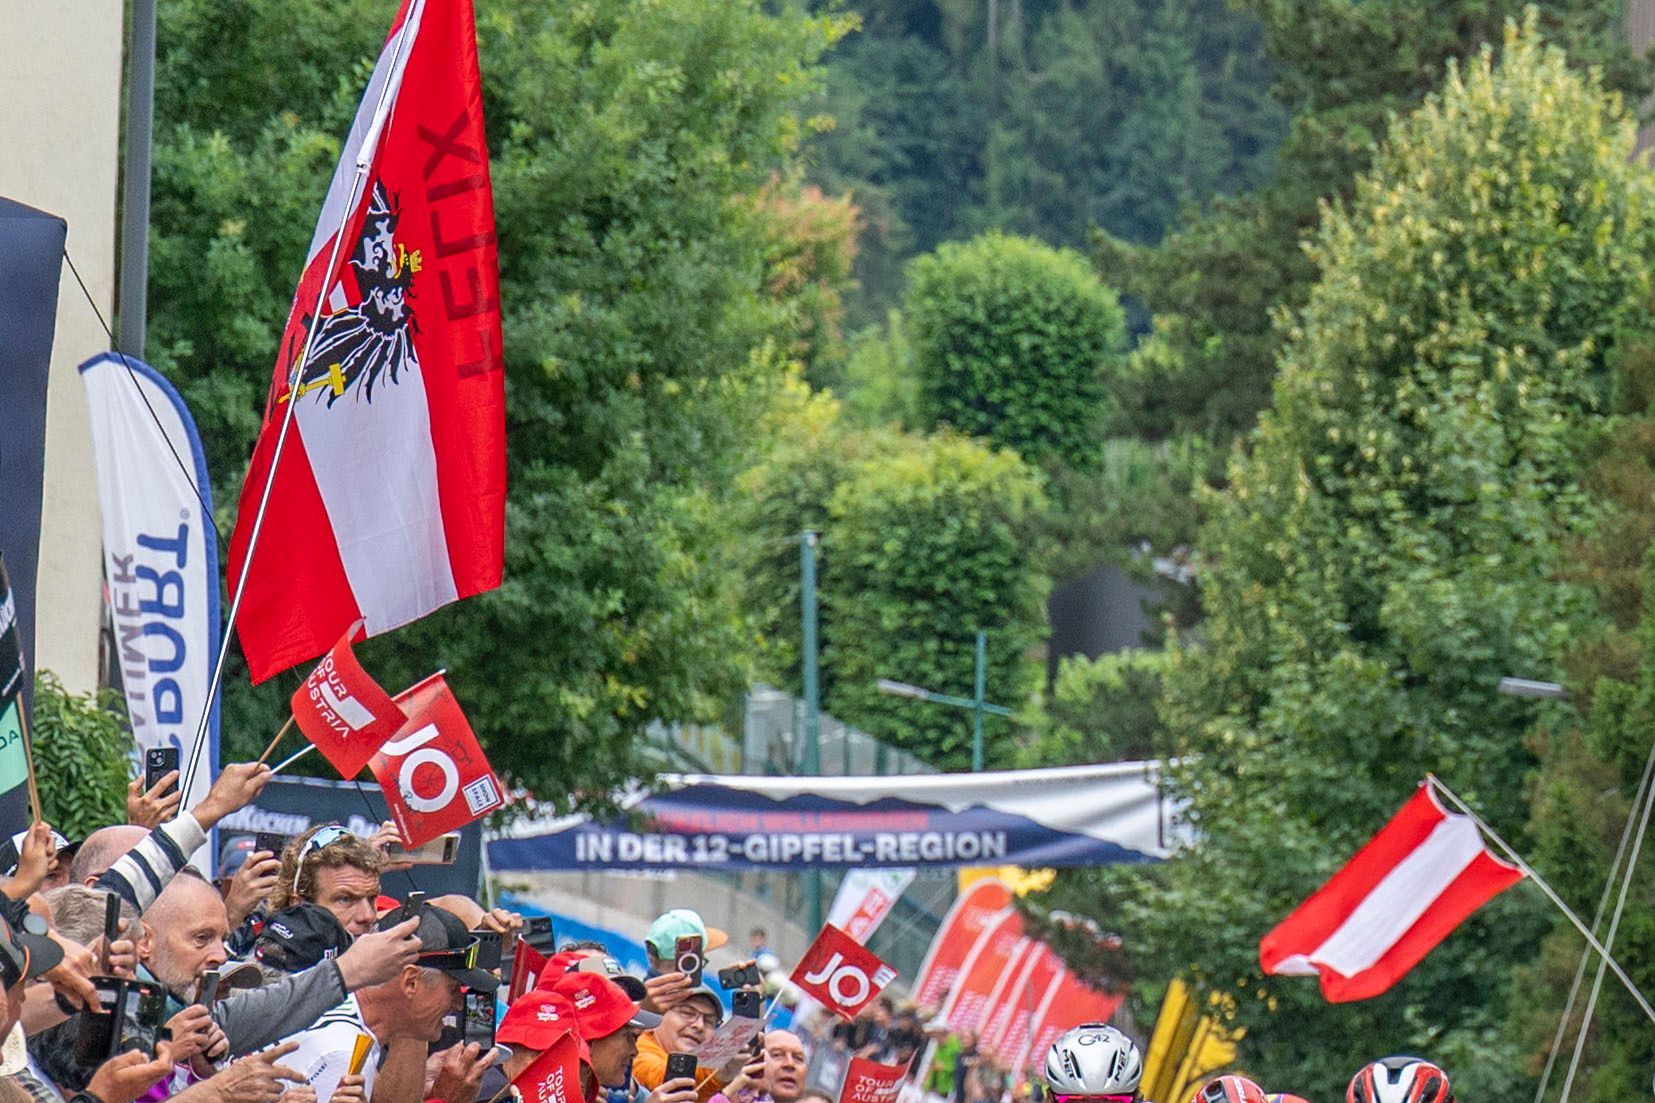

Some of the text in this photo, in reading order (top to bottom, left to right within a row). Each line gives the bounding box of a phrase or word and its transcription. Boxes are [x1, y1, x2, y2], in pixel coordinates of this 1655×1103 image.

[307, 670, 351, 740] USTRIA
[379, 722, 460, 814] JO
[575, 829, 1008, 864] IN DER 12-GIPFEL-REGION
[804, 952, 871, 1007] JO
[545, 1073, 557, 1093] OF
